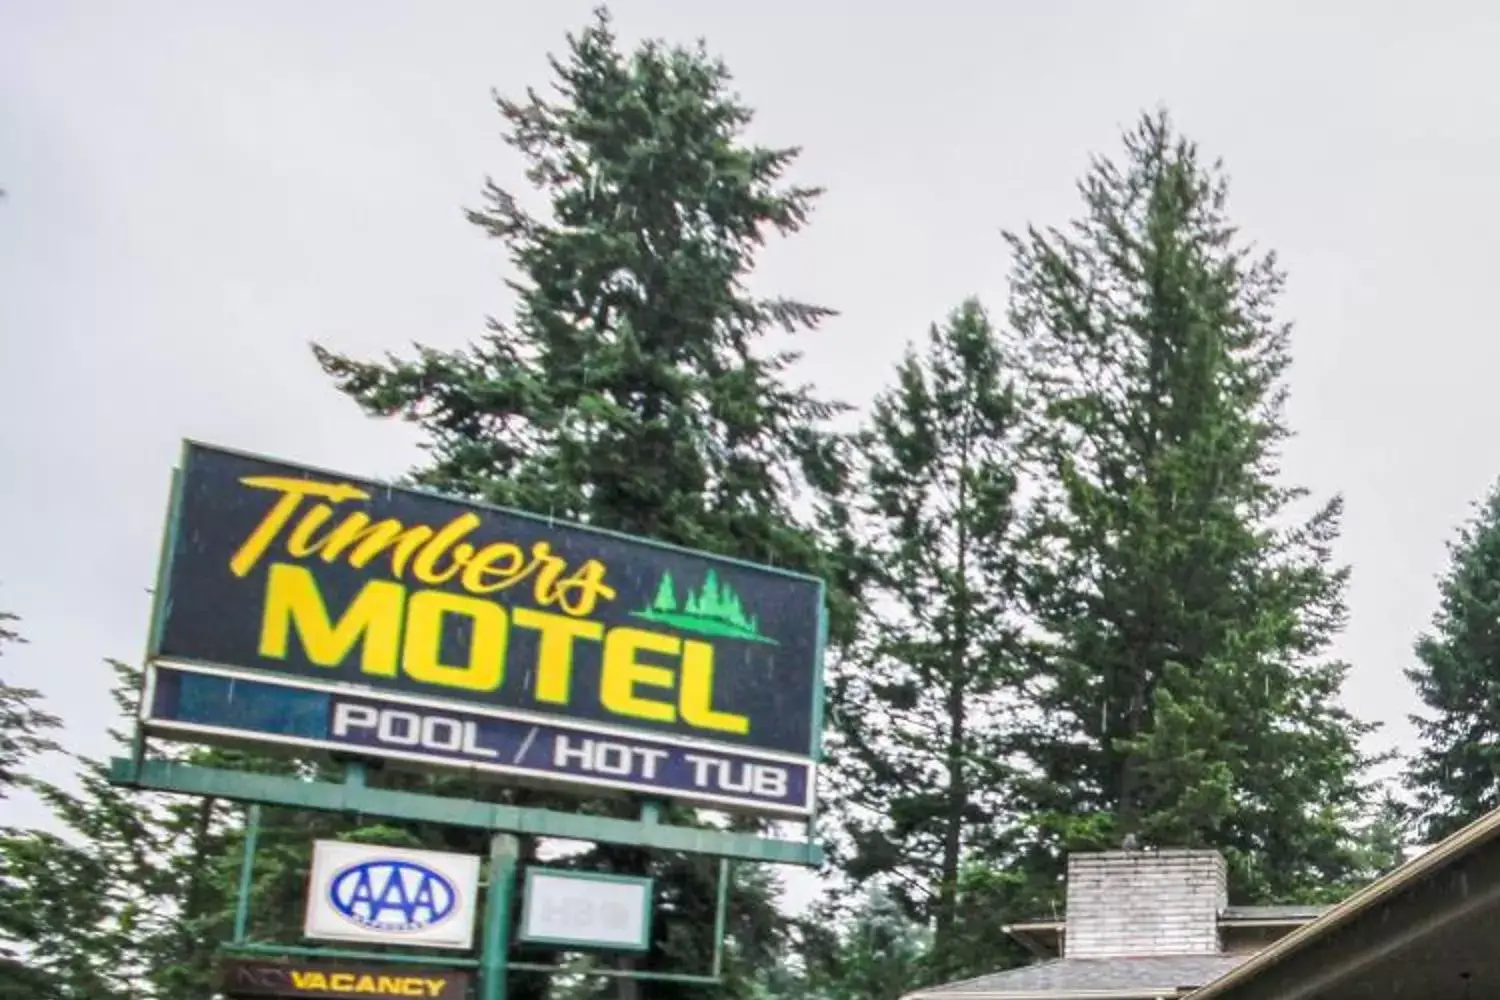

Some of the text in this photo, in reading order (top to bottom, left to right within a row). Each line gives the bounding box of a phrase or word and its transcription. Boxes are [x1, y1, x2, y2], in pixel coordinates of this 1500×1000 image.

[230, 476, 617, 616] Timbers
[259, 562, 750, 735] MOTEL
[332, 702, 788, 798] POOL / HOT TUB
[348, 865, 440, 924] AAA
[290, 969, 448, 998] VACANCY
